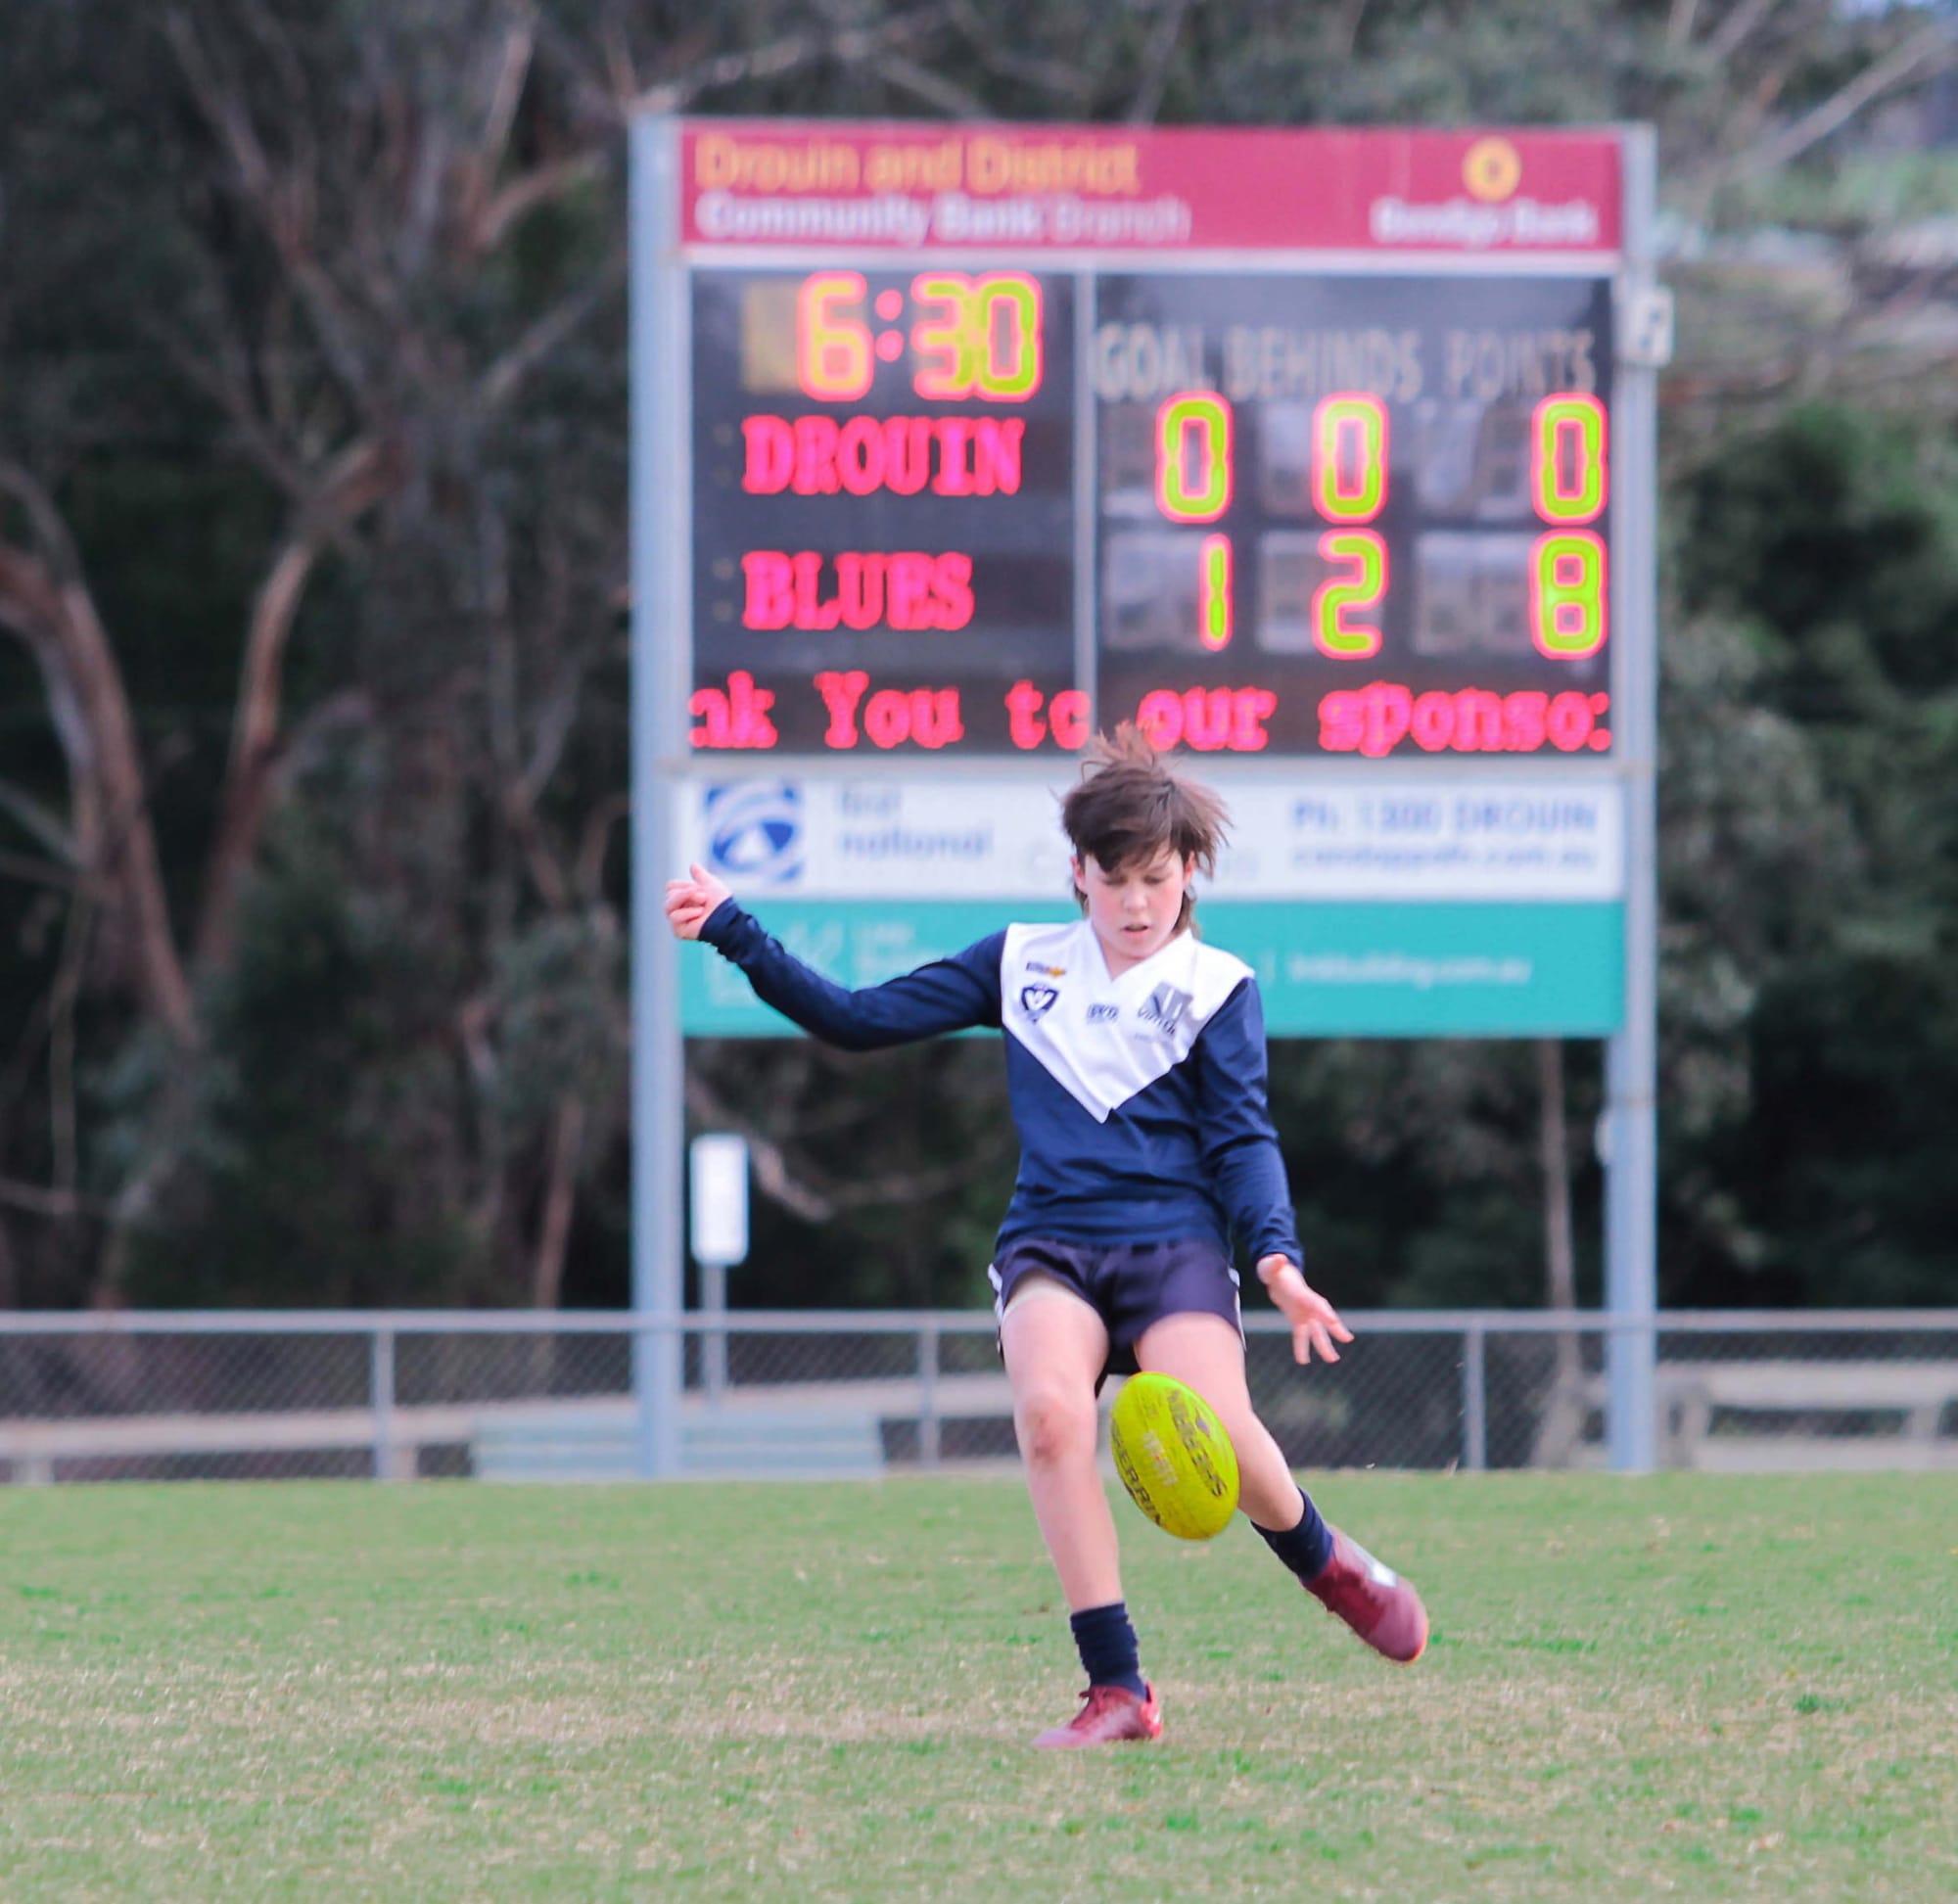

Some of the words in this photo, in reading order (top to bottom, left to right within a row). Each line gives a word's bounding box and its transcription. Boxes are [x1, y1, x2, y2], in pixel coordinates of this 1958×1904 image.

[696, 135, 859, 191] Drouin
[865, 139, 962, 192] and
[967, 135, 1139, 194] District
[696, 188, 931, 247] Community
[933, 190, 1047, 242] Bank
[1049, 192, 1190, 244] Branch
[797, 271, 1043, 402] 6:30
[1092, 323, 1215, 400] GOAL
[1222, 326, 1422, 400] BEHINDS
[1445, 327, 1596, 396] POINTS
[741, 415, 1026, 495] DROUIN
[1155, 392, 1234, 524] 0
[1312, 392, 1389, 525] 0
[1531, 392, 1608, 526] 0
[741, 550, 974, 630] BLUES
[1199, 533, 1233, 652] 1
[1312, 527, 1389, 660] 2
[1529, 528, 1608, 661] 8
[814, 671, 964, 749] You
[1137, 686, 1277, 752] our
